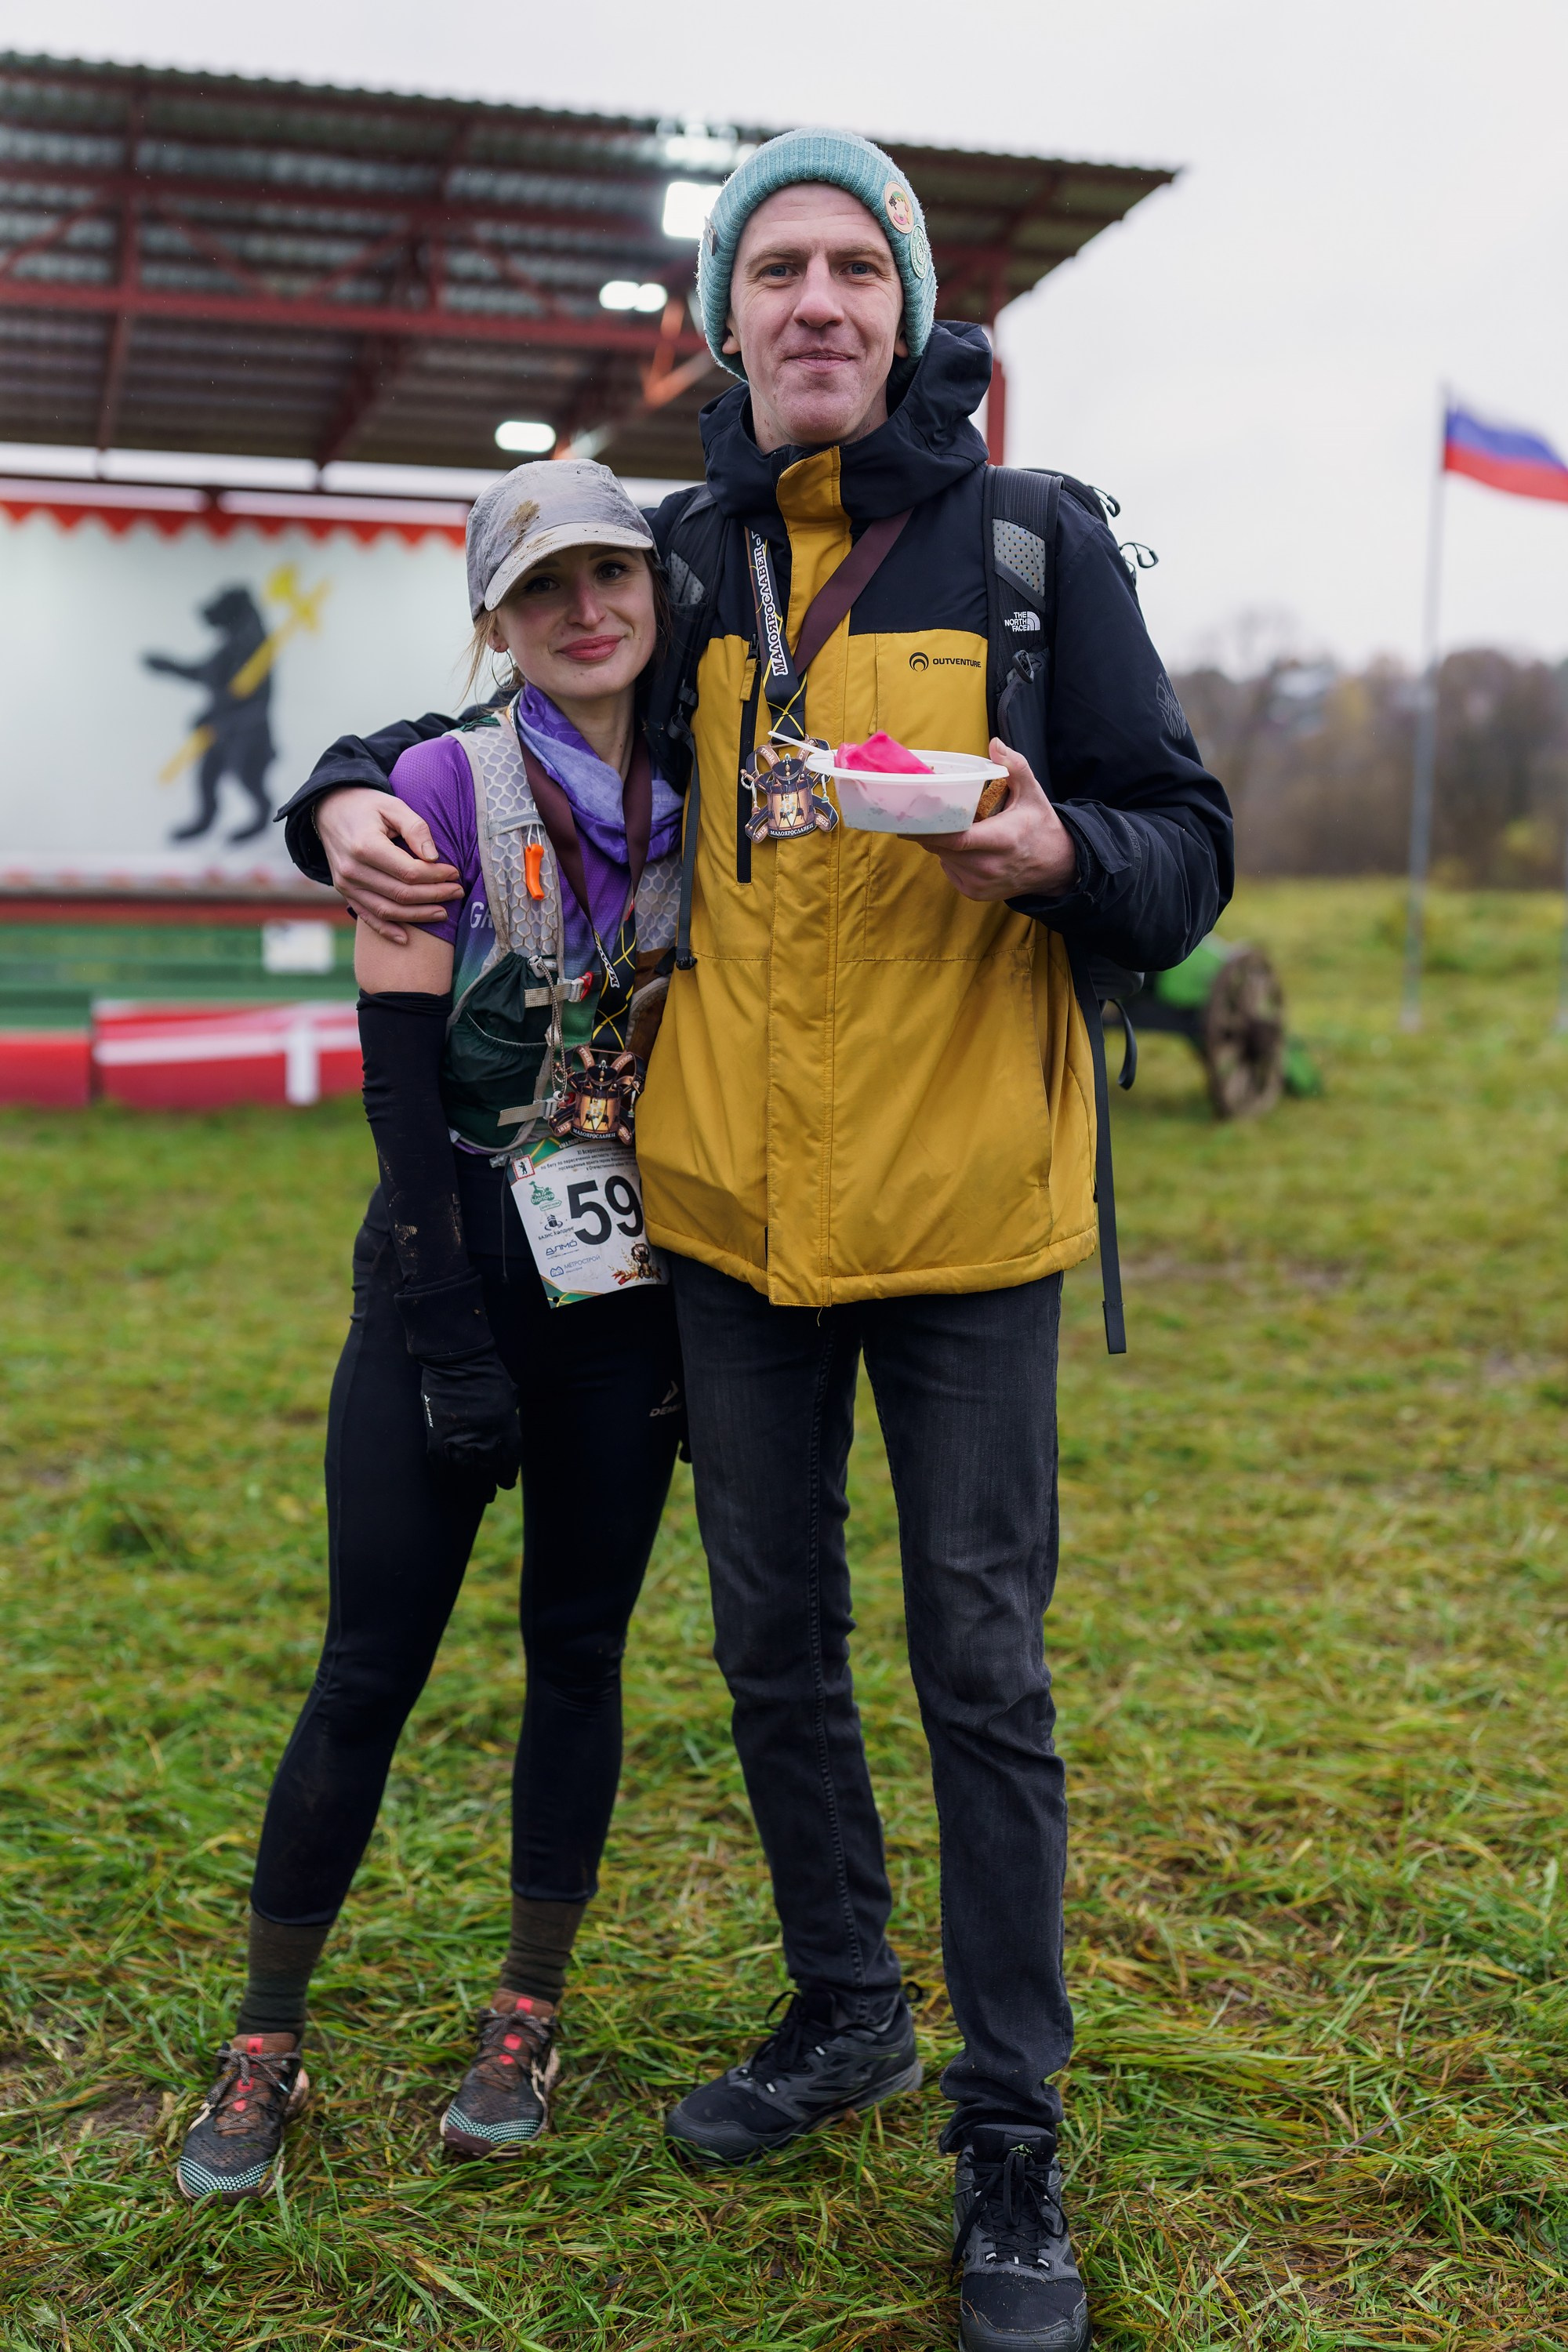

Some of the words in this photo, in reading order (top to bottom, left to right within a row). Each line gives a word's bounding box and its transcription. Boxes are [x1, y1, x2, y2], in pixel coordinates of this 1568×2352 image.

[754, 544, 787, 676] МАЛОЯРОСЛАВЕЦ
[1004, 618, 1027, 627] NORTH
[1011, 624, 1028, 633] FACE
[932, 657, 982, 668] OUTVENTURE
[760, 747, 775, 765] ТРЕЙЛ
[815, 815, 829, 827] 2025
[770, 823, 814, 837] МАЛОЯРОСЛАВЕЦ
[531, 1193, 554, 1203] bionova
[567, 1175, 644, 1245] 59
[564, 1254, 601, 1269] МЕТРОСТРОЙ
